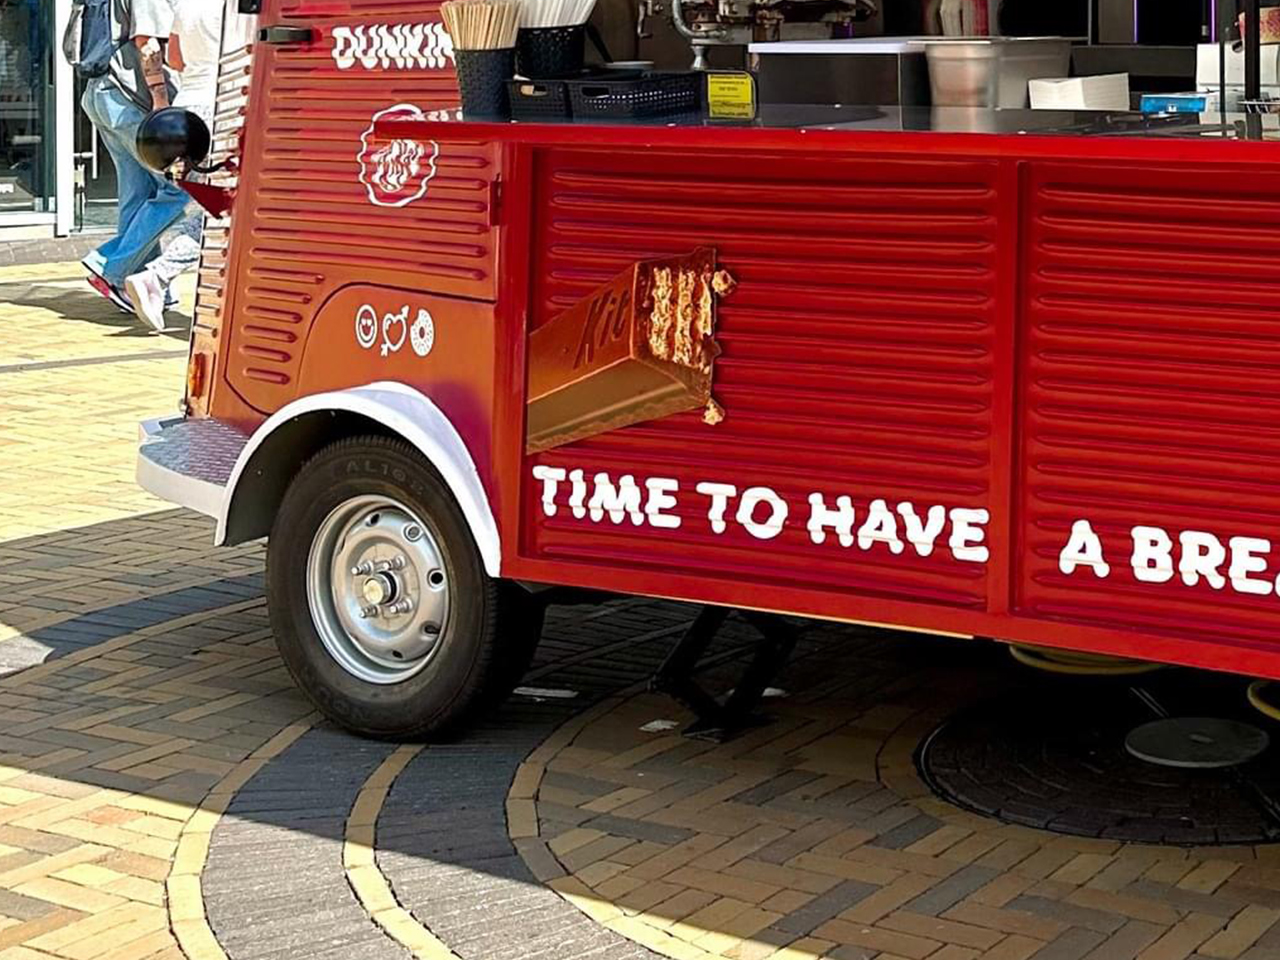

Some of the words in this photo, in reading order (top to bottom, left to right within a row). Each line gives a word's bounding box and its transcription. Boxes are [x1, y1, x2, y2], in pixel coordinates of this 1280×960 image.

[532, 465, 682, 528] TIME
[696, 482, 789, 539] TO
[807, 492, 989, 563] HAVE
[1058, 519, 1110, 578] A
